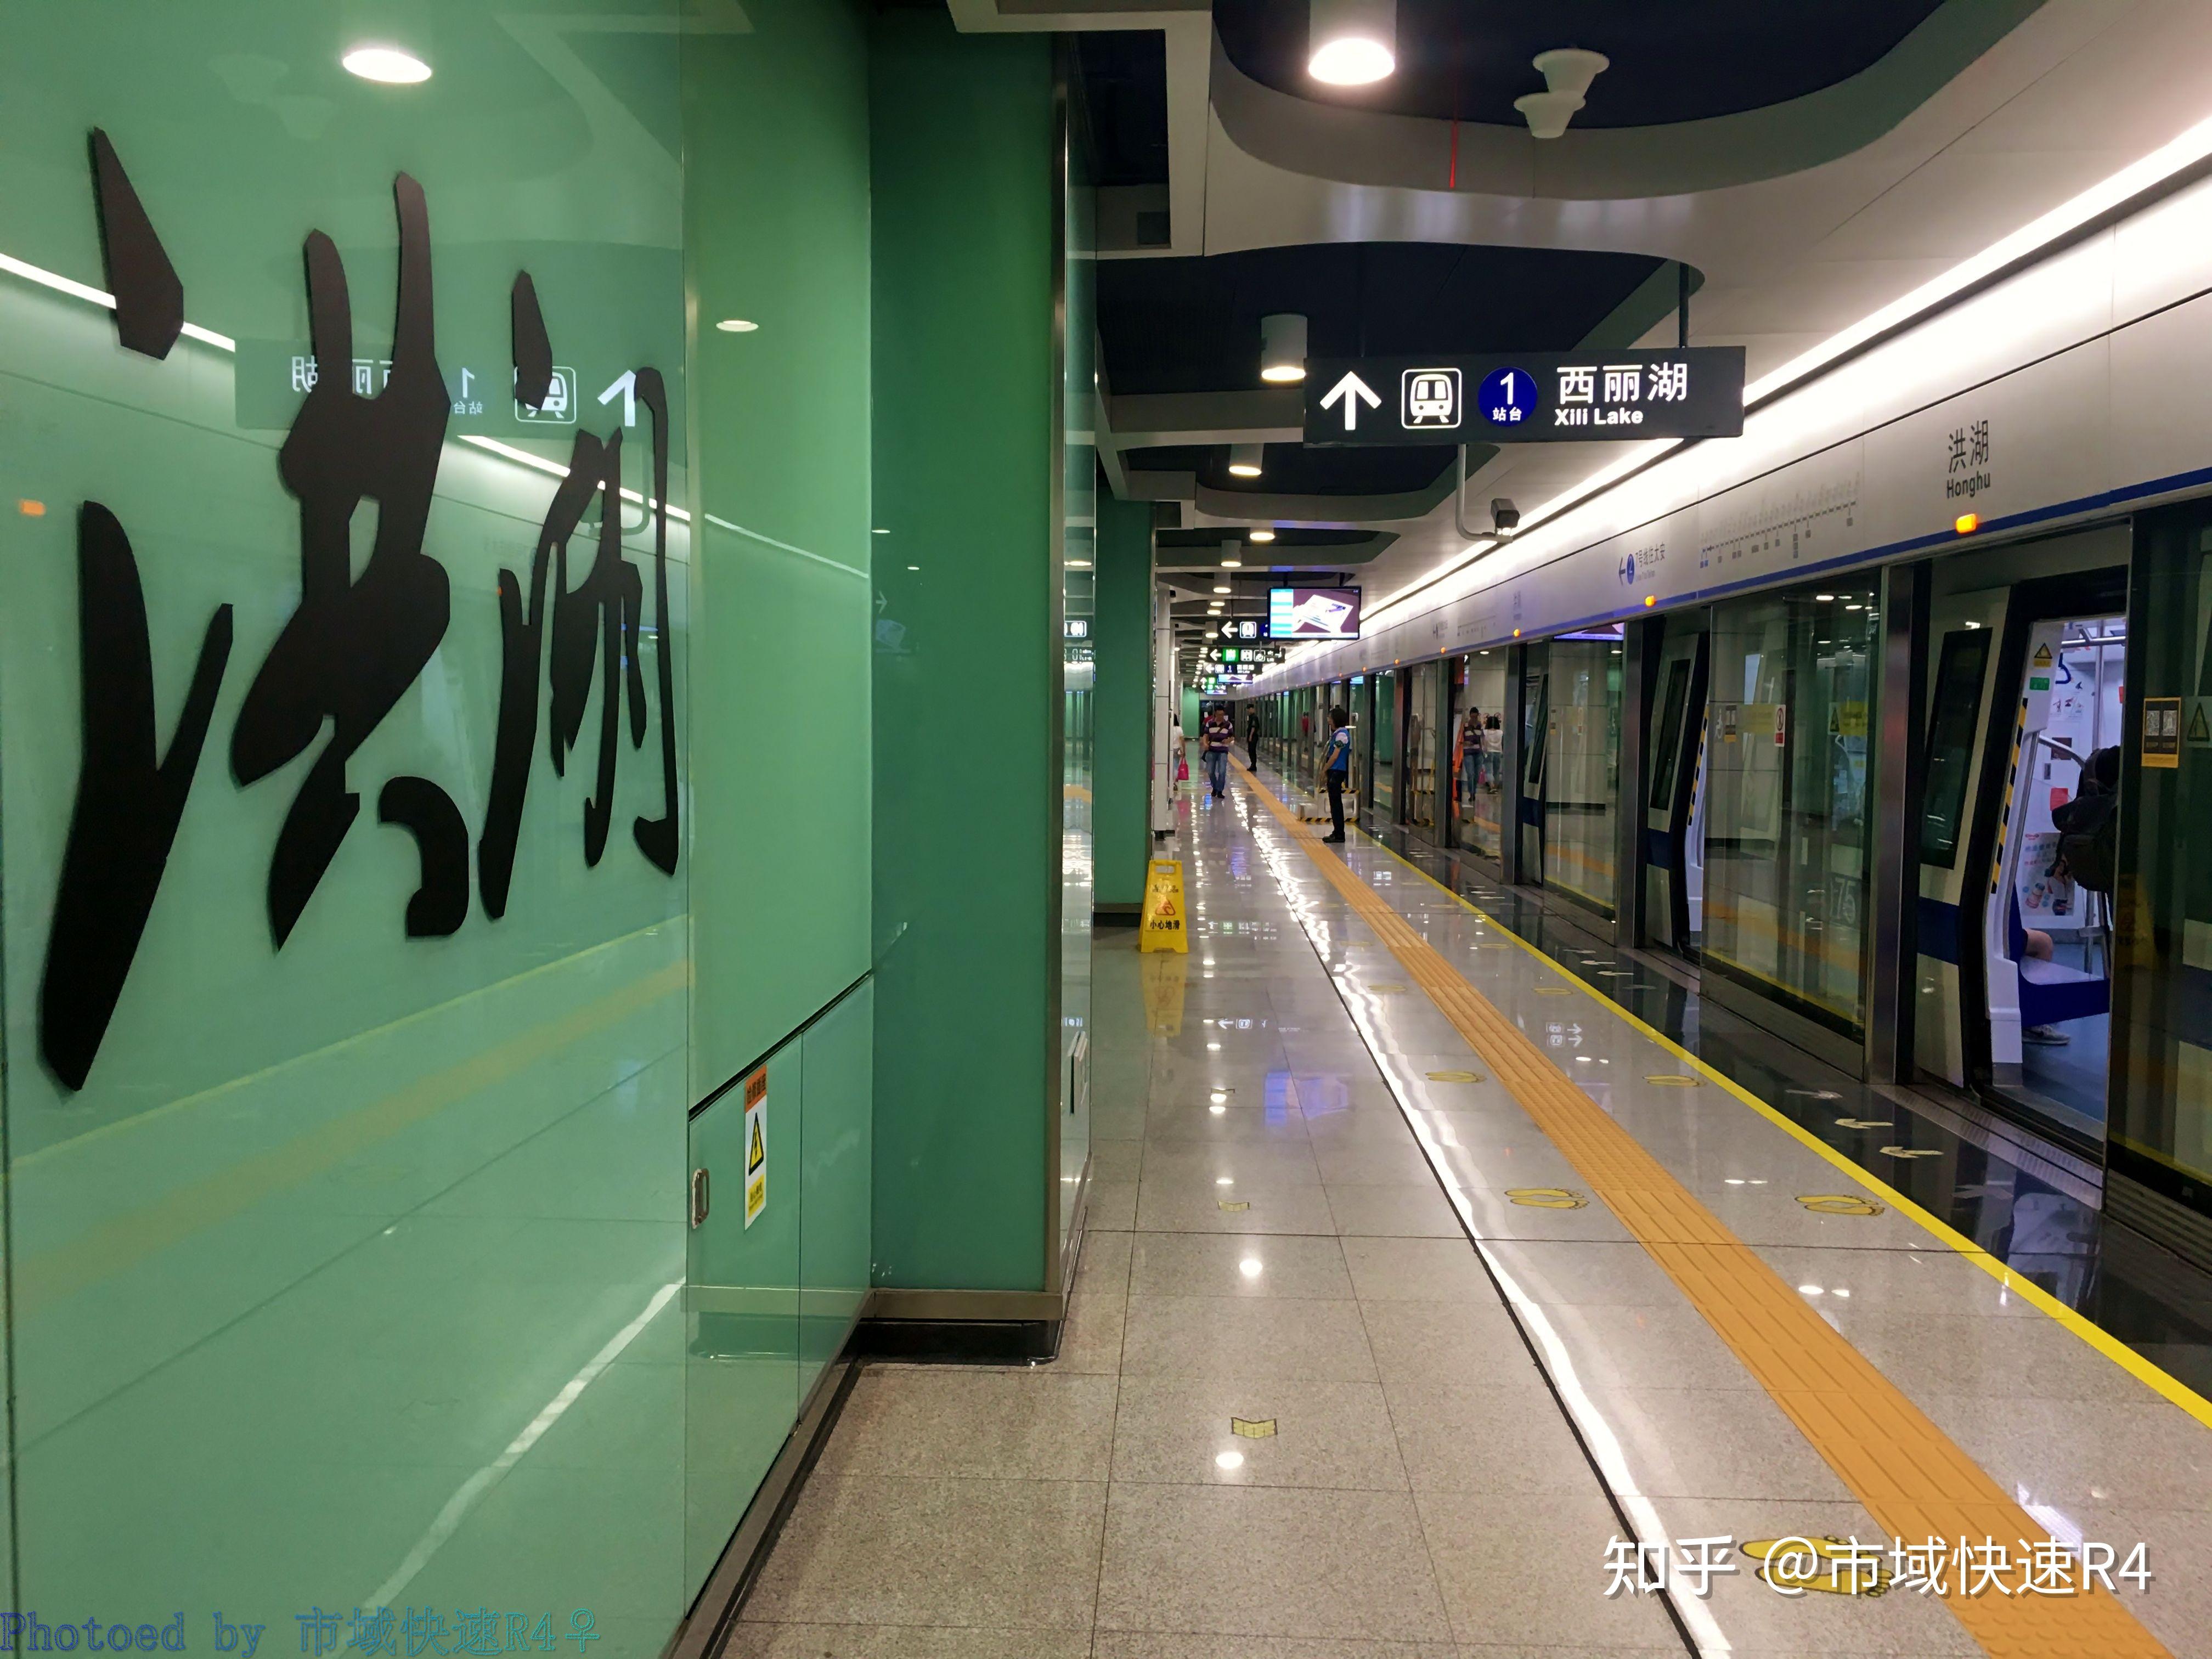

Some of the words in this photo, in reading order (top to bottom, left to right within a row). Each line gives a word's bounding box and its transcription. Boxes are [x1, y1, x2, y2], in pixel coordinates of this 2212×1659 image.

[1500, 372, 1514, 405] 1
[1556, 362, 1687, 405] 西丽湖
[1492, 407, 1522, 421] 站台
[1554, 408, 1588, 426] Xili
[1594, 407, 1644, 425] Lake
[1948, 420, 1989, 473] 洪湖
[1947, 470, 1990, 499] Honghu
[1150, 919, 1180, 930] 小心地滑
